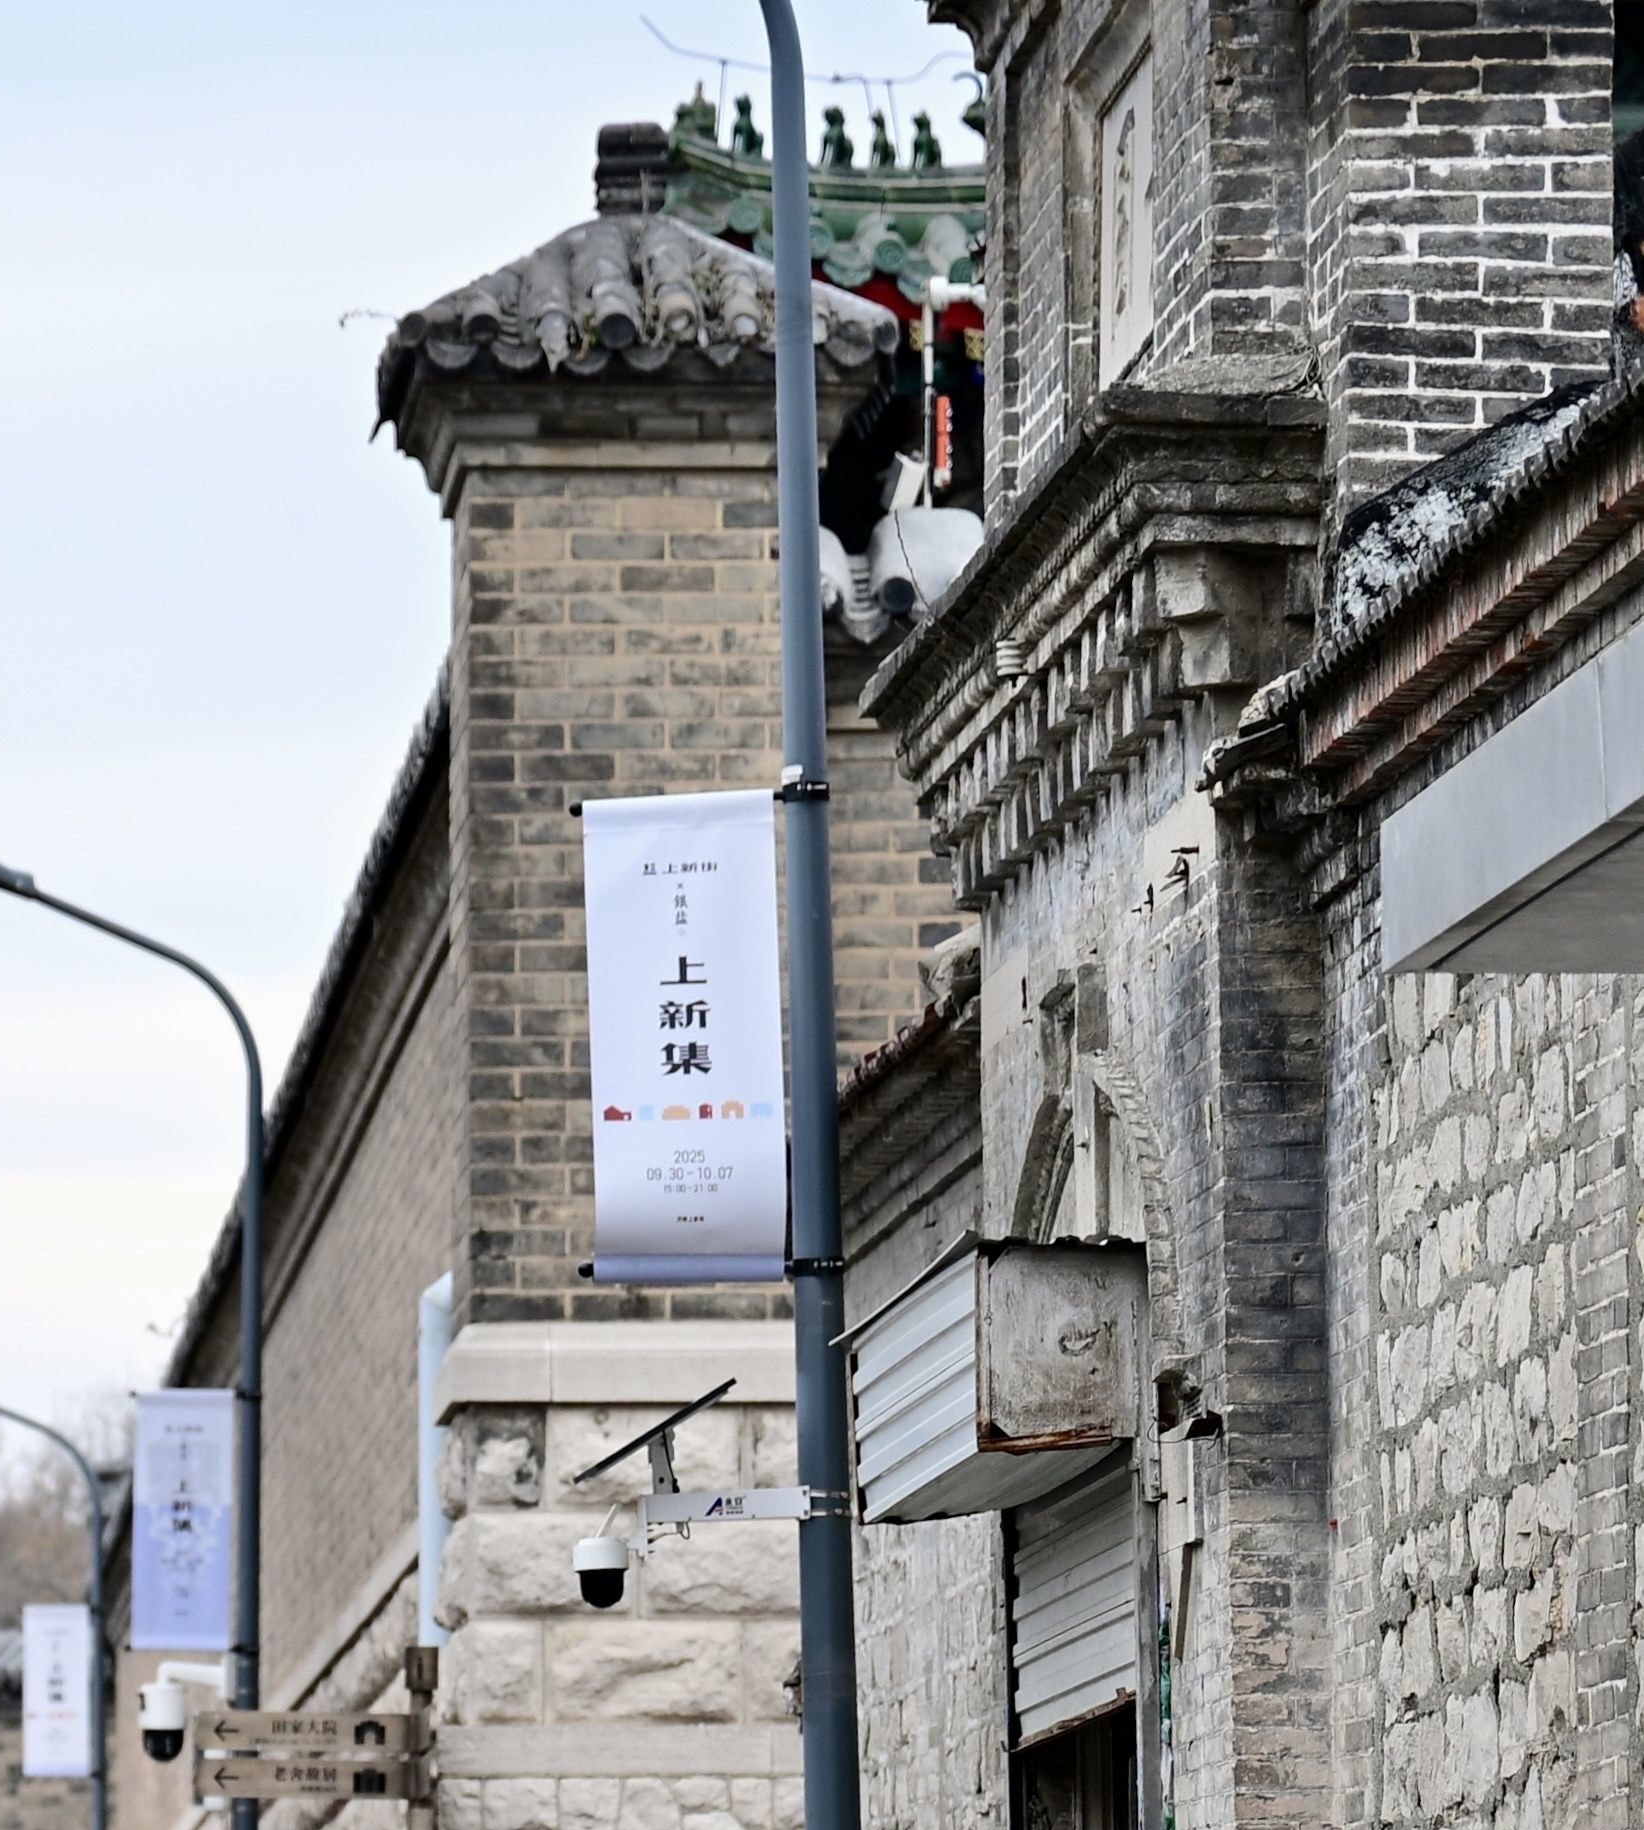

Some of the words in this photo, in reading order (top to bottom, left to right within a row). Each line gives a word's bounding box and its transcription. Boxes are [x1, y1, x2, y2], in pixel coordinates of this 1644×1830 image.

[659, 955, 713, 1076] 上新集
[673, 1149, 706, 1164] 2025
